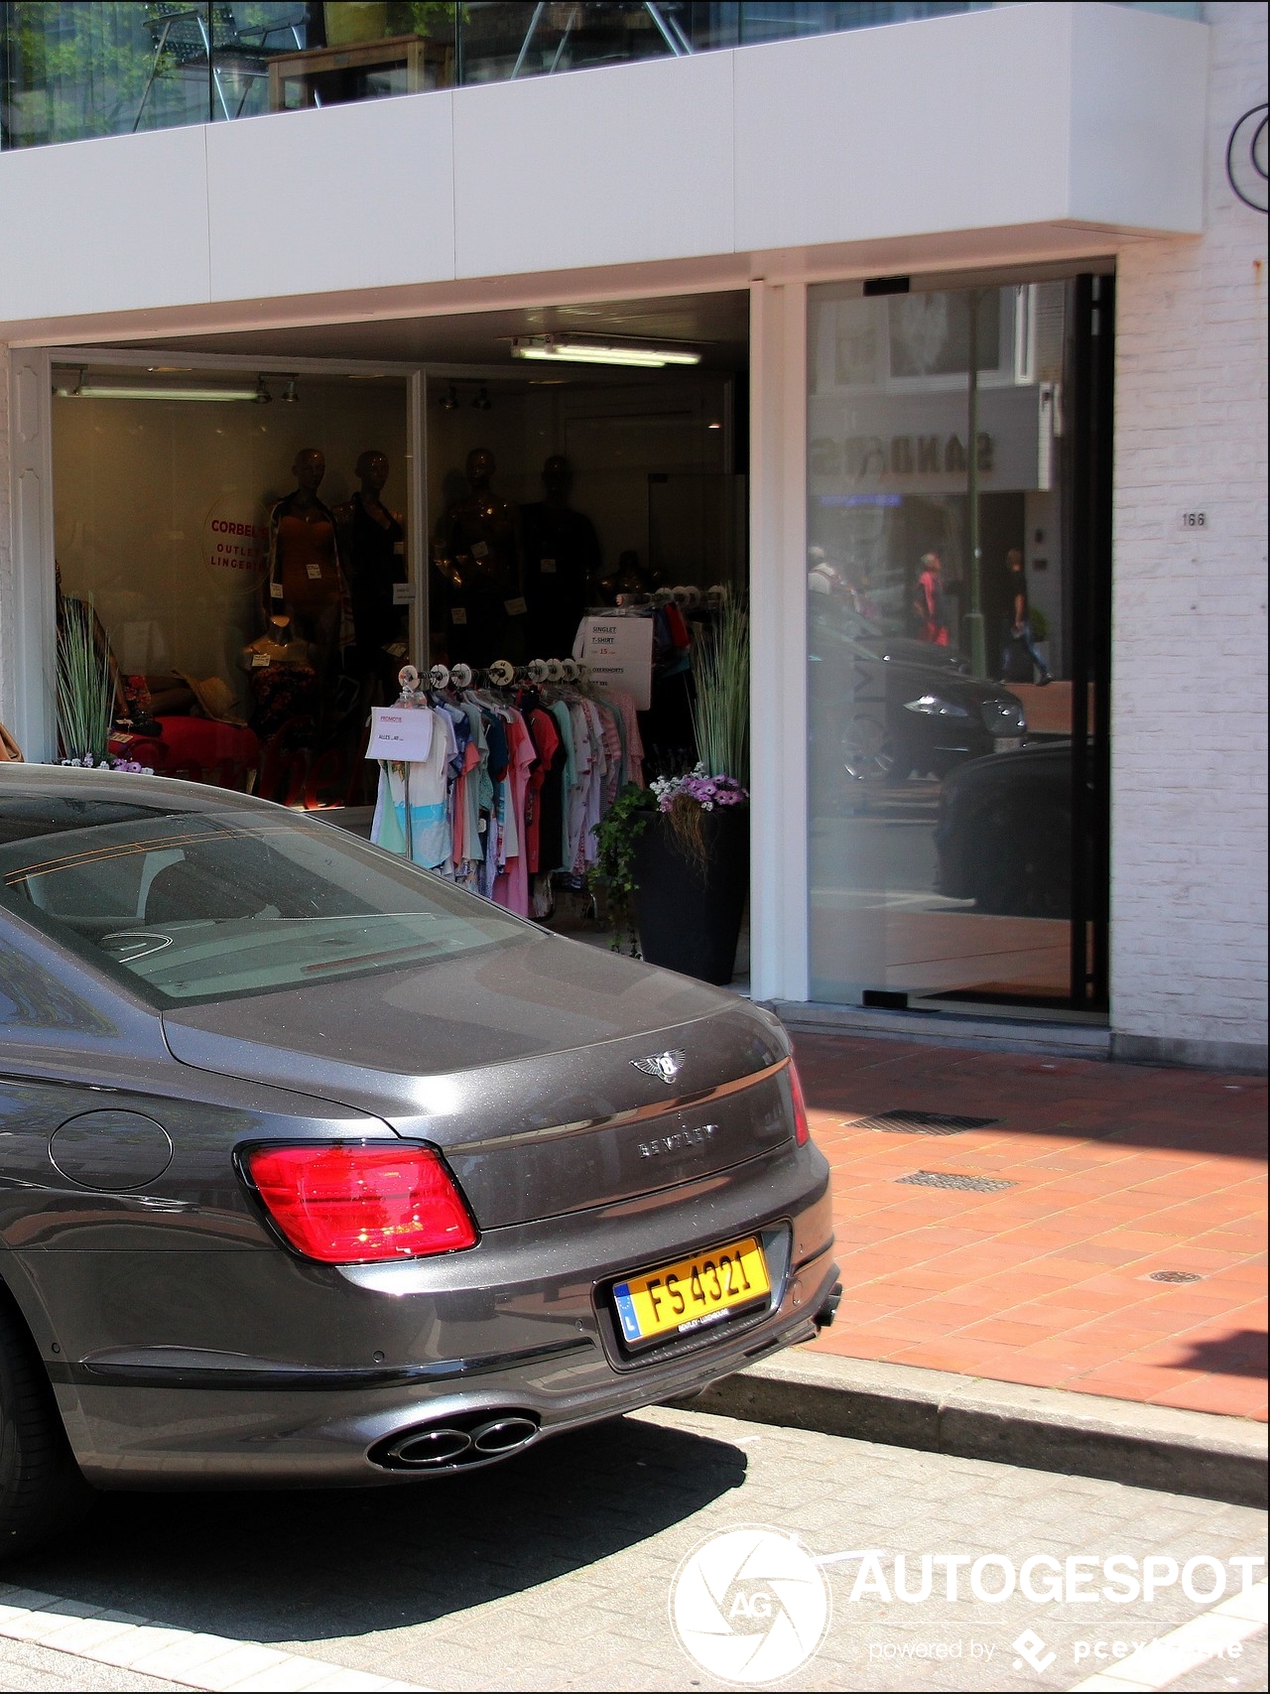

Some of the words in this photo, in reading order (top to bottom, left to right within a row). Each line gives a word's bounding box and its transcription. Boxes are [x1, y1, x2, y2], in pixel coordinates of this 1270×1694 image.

[1183, 513, 1205, 526] 166
[638, 1124, 718, 1159] BENTLEY
[646, 1273, 685, 1322] FS
[691, 1250, 751, 1305] 4321
[625, 1315, 635, 1331] L
